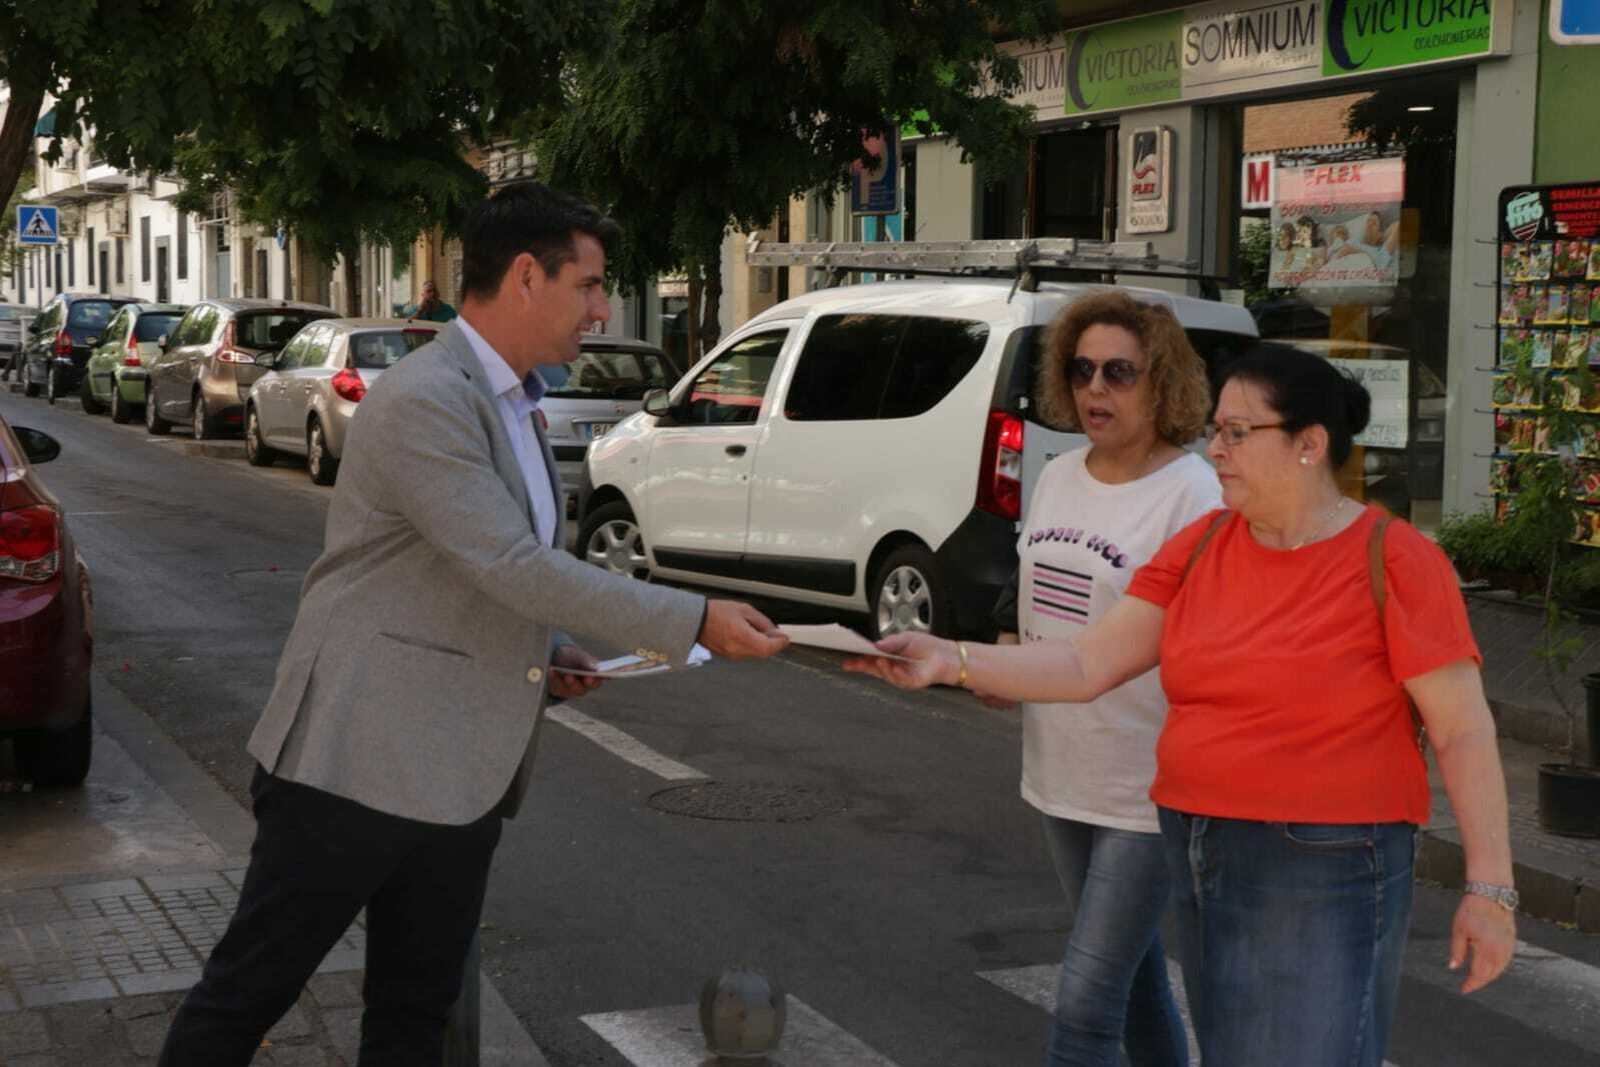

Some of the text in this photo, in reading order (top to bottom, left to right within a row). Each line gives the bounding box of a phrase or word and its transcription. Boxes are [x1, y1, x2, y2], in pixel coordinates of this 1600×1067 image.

[1185, 3, 1316, 66] SOMNIUM
[1085, 41, 1178, 83] VICTORIA
[1247, 160, 1271, 203] M
[1315, 163, 1364, 186] FLEX
